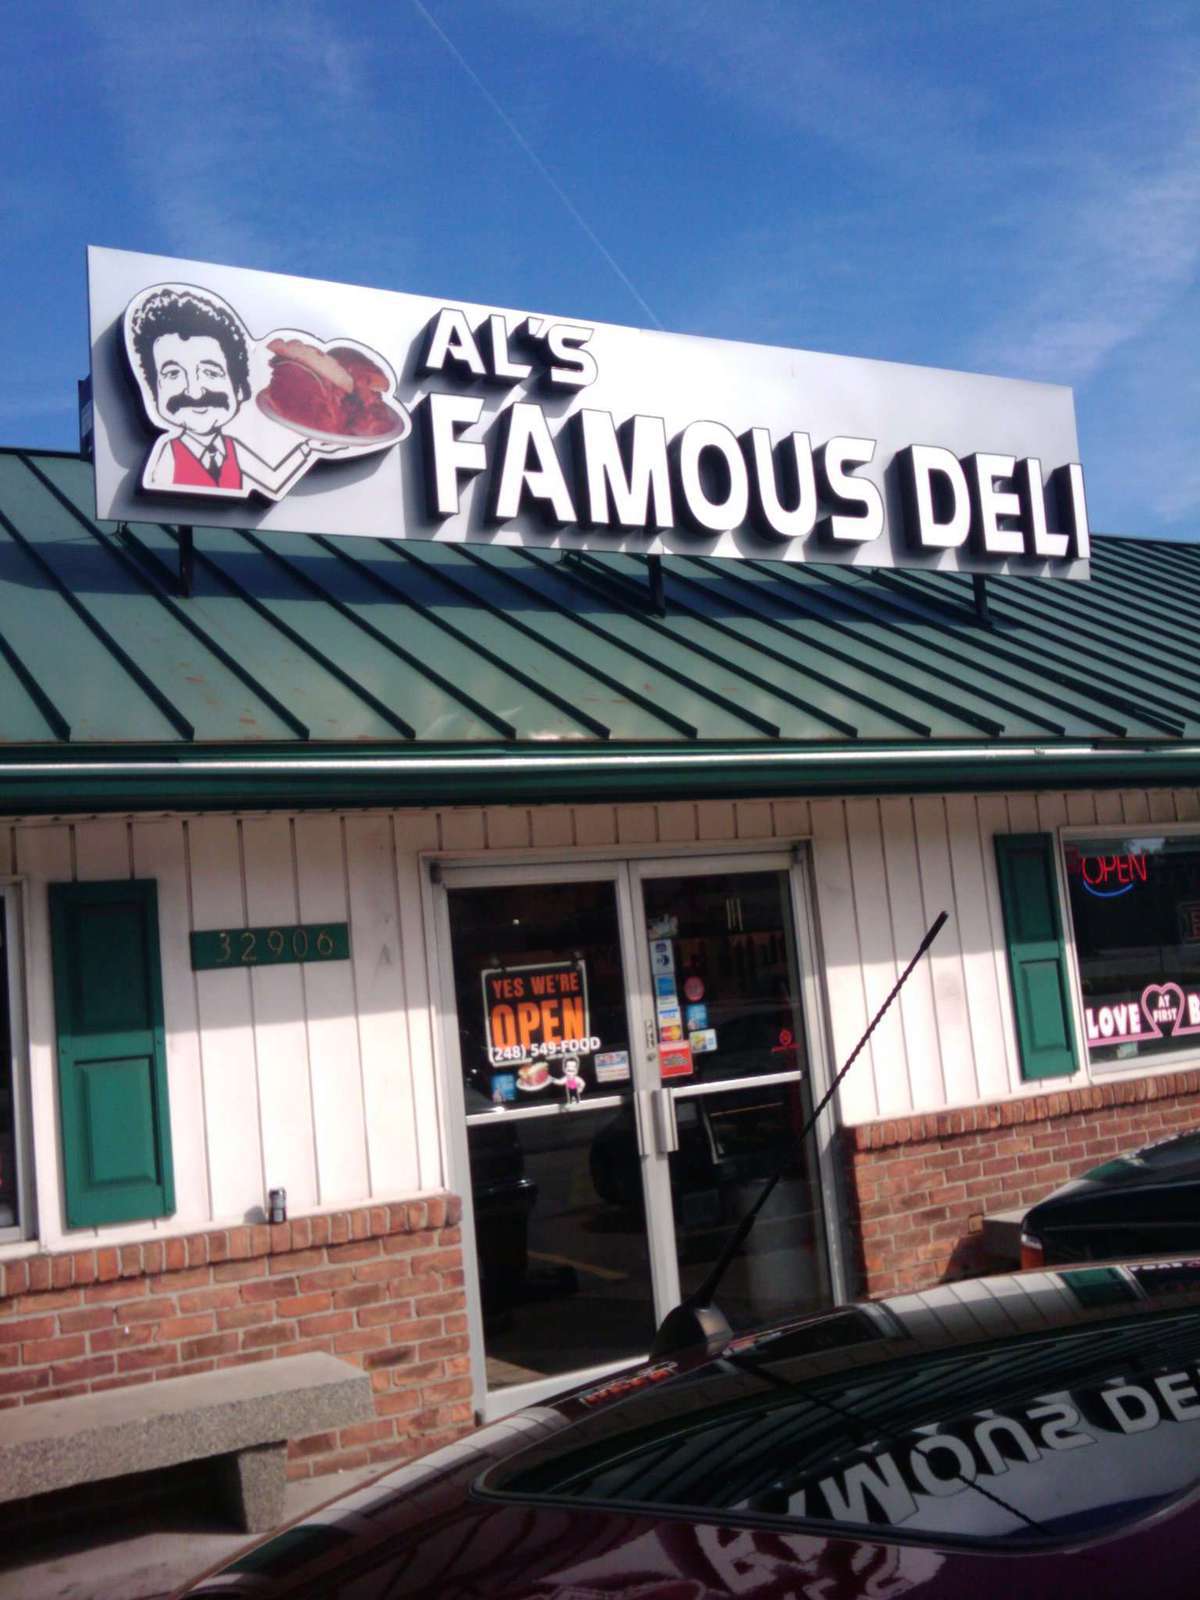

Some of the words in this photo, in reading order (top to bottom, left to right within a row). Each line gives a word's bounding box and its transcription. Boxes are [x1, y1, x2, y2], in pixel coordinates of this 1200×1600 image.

[424, 308, 598, 386] AL'S
[429, 392, 886, 542] FAMOUS
[911, 444, 1090, 558] DELI
[1081, 853, 1147, 884] OPEN
[215, 930, 335, 963] 32906
[492, 977, 525, 999] YES
[530, 972, 579, 996] WE'RE
[1158, 994, 1170, 1008] AT
[491, 997, 585, 1051] OPEN
[1085, 1003, 1141, 1039] LOVE
[1152, 1007, 1178, 1023] FIRST
[488, 1044, 527, 1062] (248)
[531, 1036, 601, 1057] 549-FOOD
